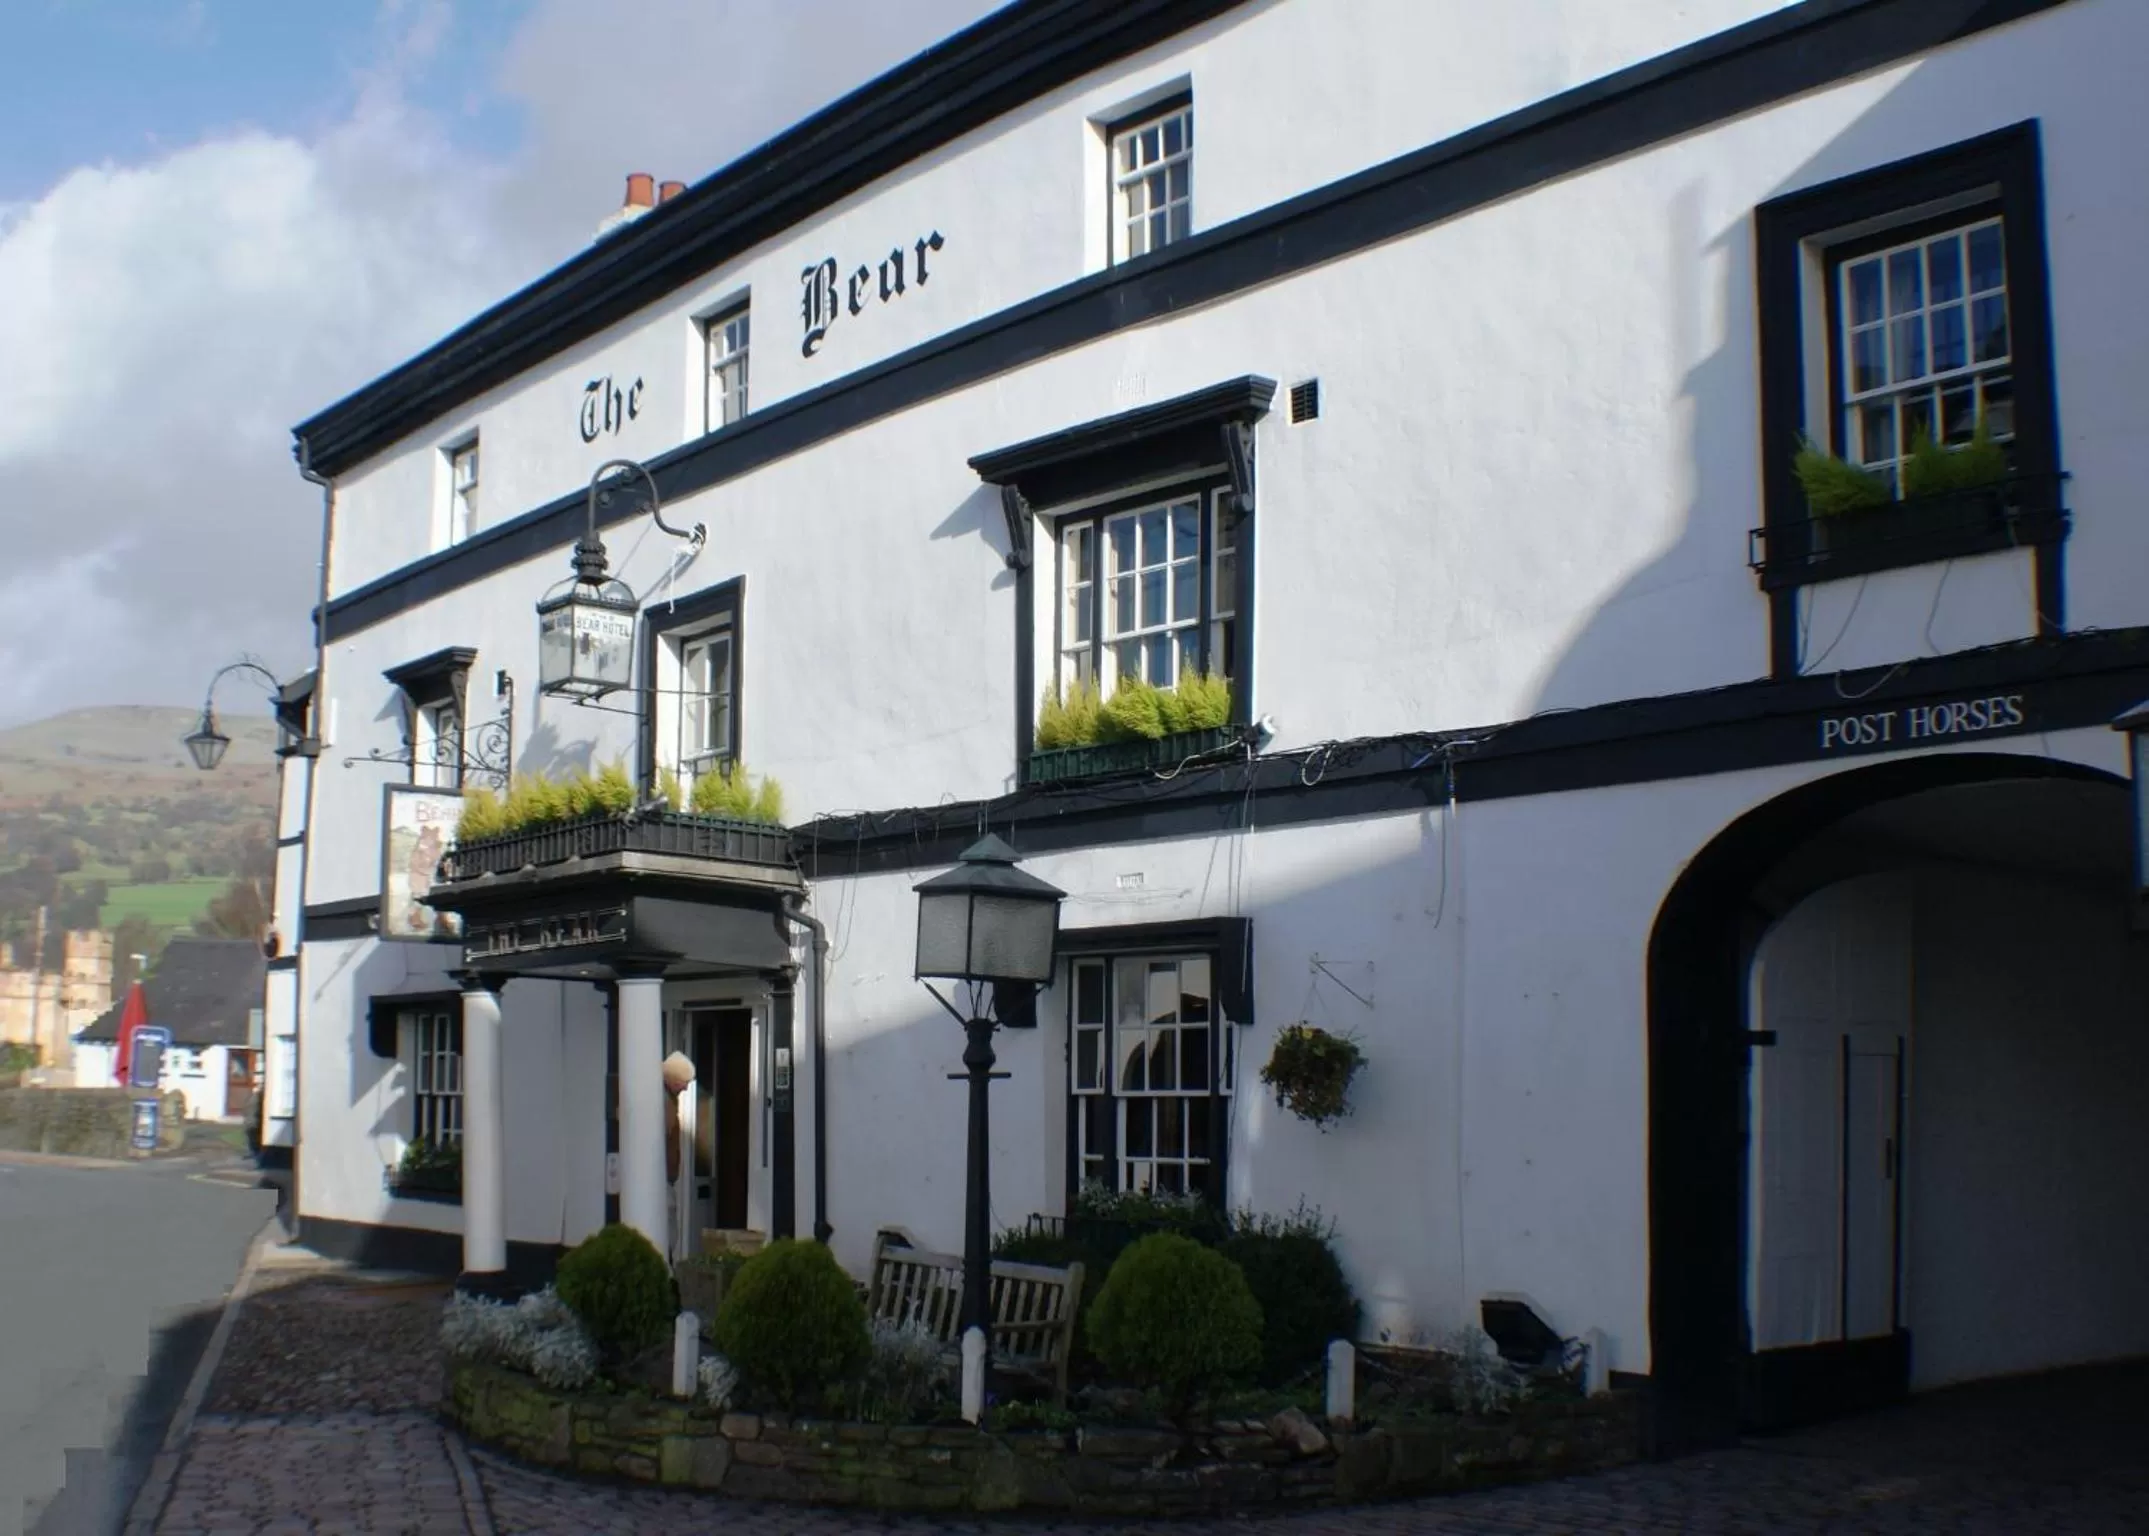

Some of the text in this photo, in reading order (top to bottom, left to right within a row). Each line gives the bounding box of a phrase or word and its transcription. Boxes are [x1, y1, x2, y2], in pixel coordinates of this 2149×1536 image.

[580, 230, 944, 443] The Bear
[576, 616, 600, 631] BEAR
[602, 621, 630, 638] HOTEL
[1821, 695, 2024, 748] POST HORSES
